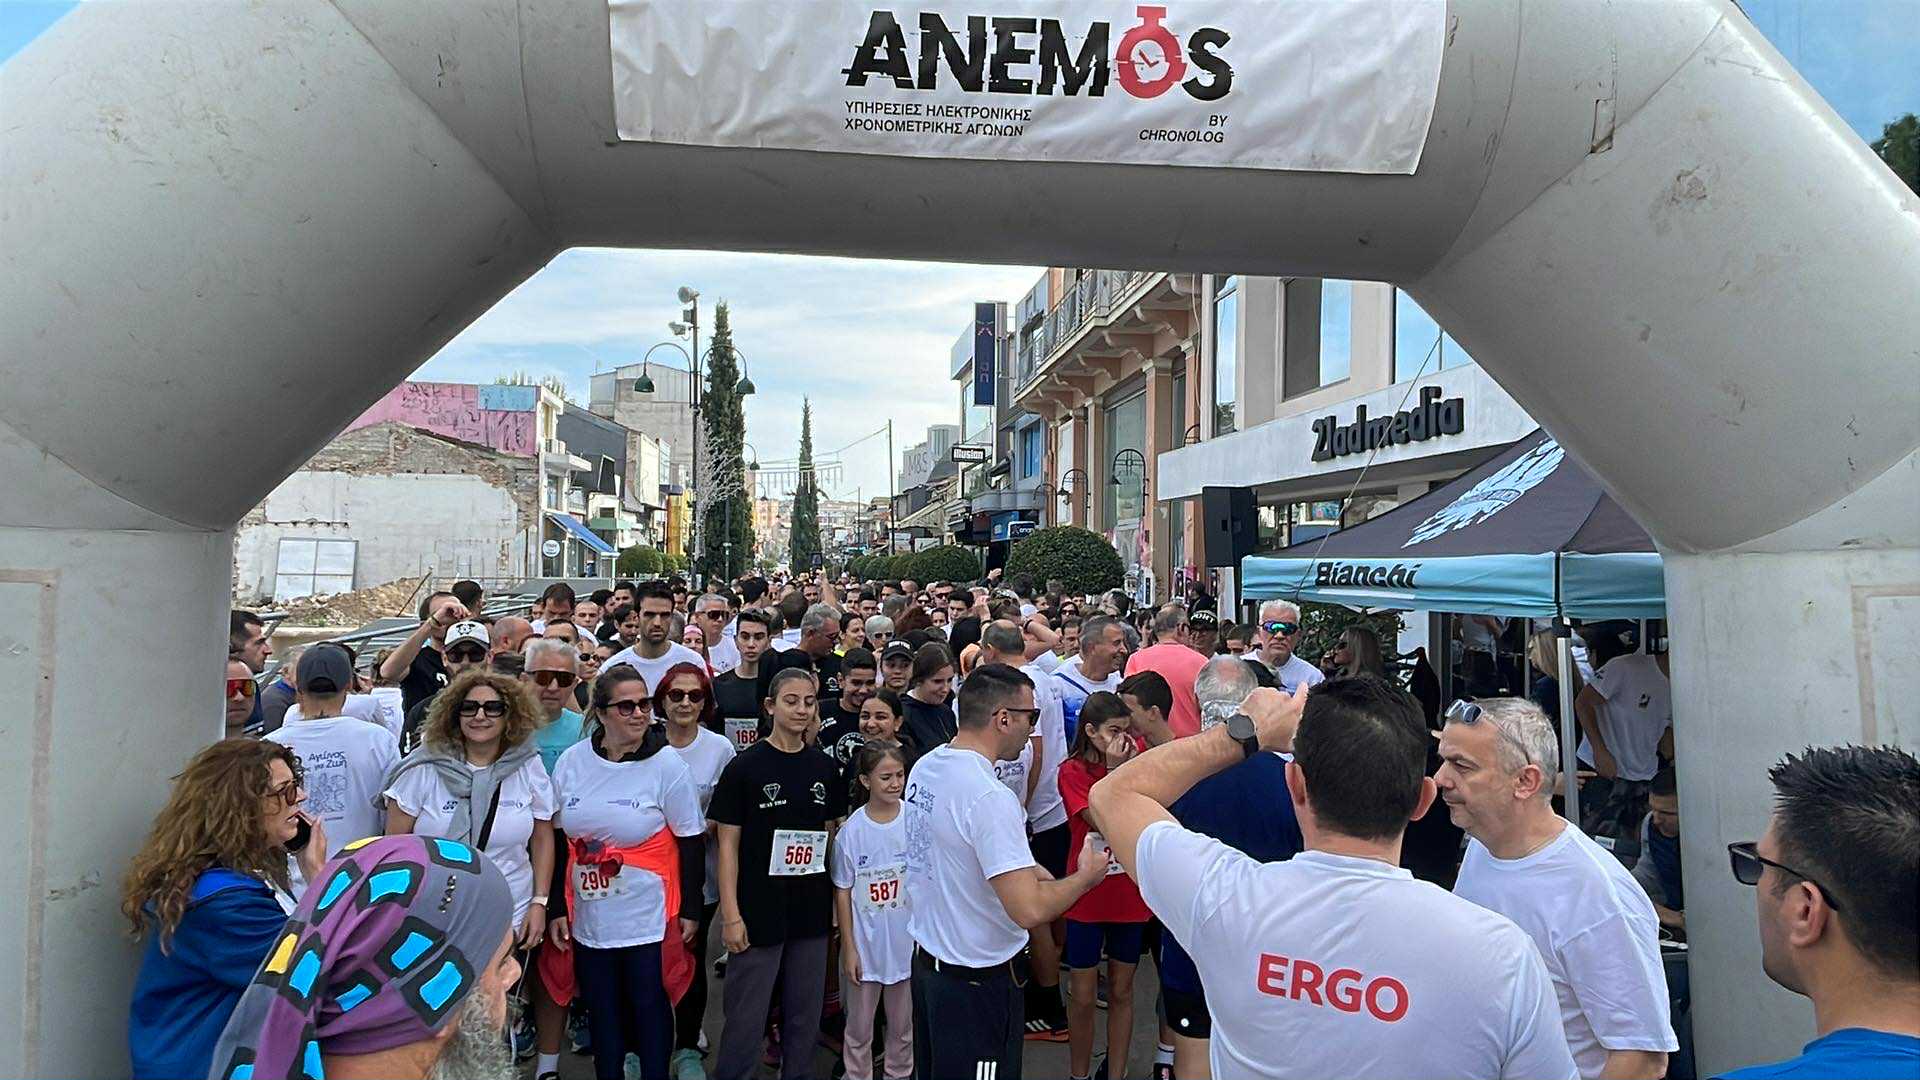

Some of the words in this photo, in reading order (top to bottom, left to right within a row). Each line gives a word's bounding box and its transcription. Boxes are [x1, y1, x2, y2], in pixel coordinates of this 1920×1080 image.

[842, 6, 1233, 101] ANEMOS
[845, 101, 922, 116] ΥΠΗΡΕΣΙΕΣ
[926, 105, 1032, 121] ΗΛΕΚΤΡΟΝΙΚΗΣ
[1209, 115, 1228, 126] BY
[844, 118, 963, 135] ΧΡΟΝΟΜΕΤΡΙΚΗΣ
[966, 123, 1024, 137] ΑΓΩΝΩΝ
[1139, 129, 1225, 143] CHRONOLOG
[1315, 562, 1422, 589] Bianchi
[735, 729, 758, 744] 168
[785, 845, 813, 865] 566
[869, 879, 899, 902] 587
[1257, 952, 1409, 1023] ERGO
